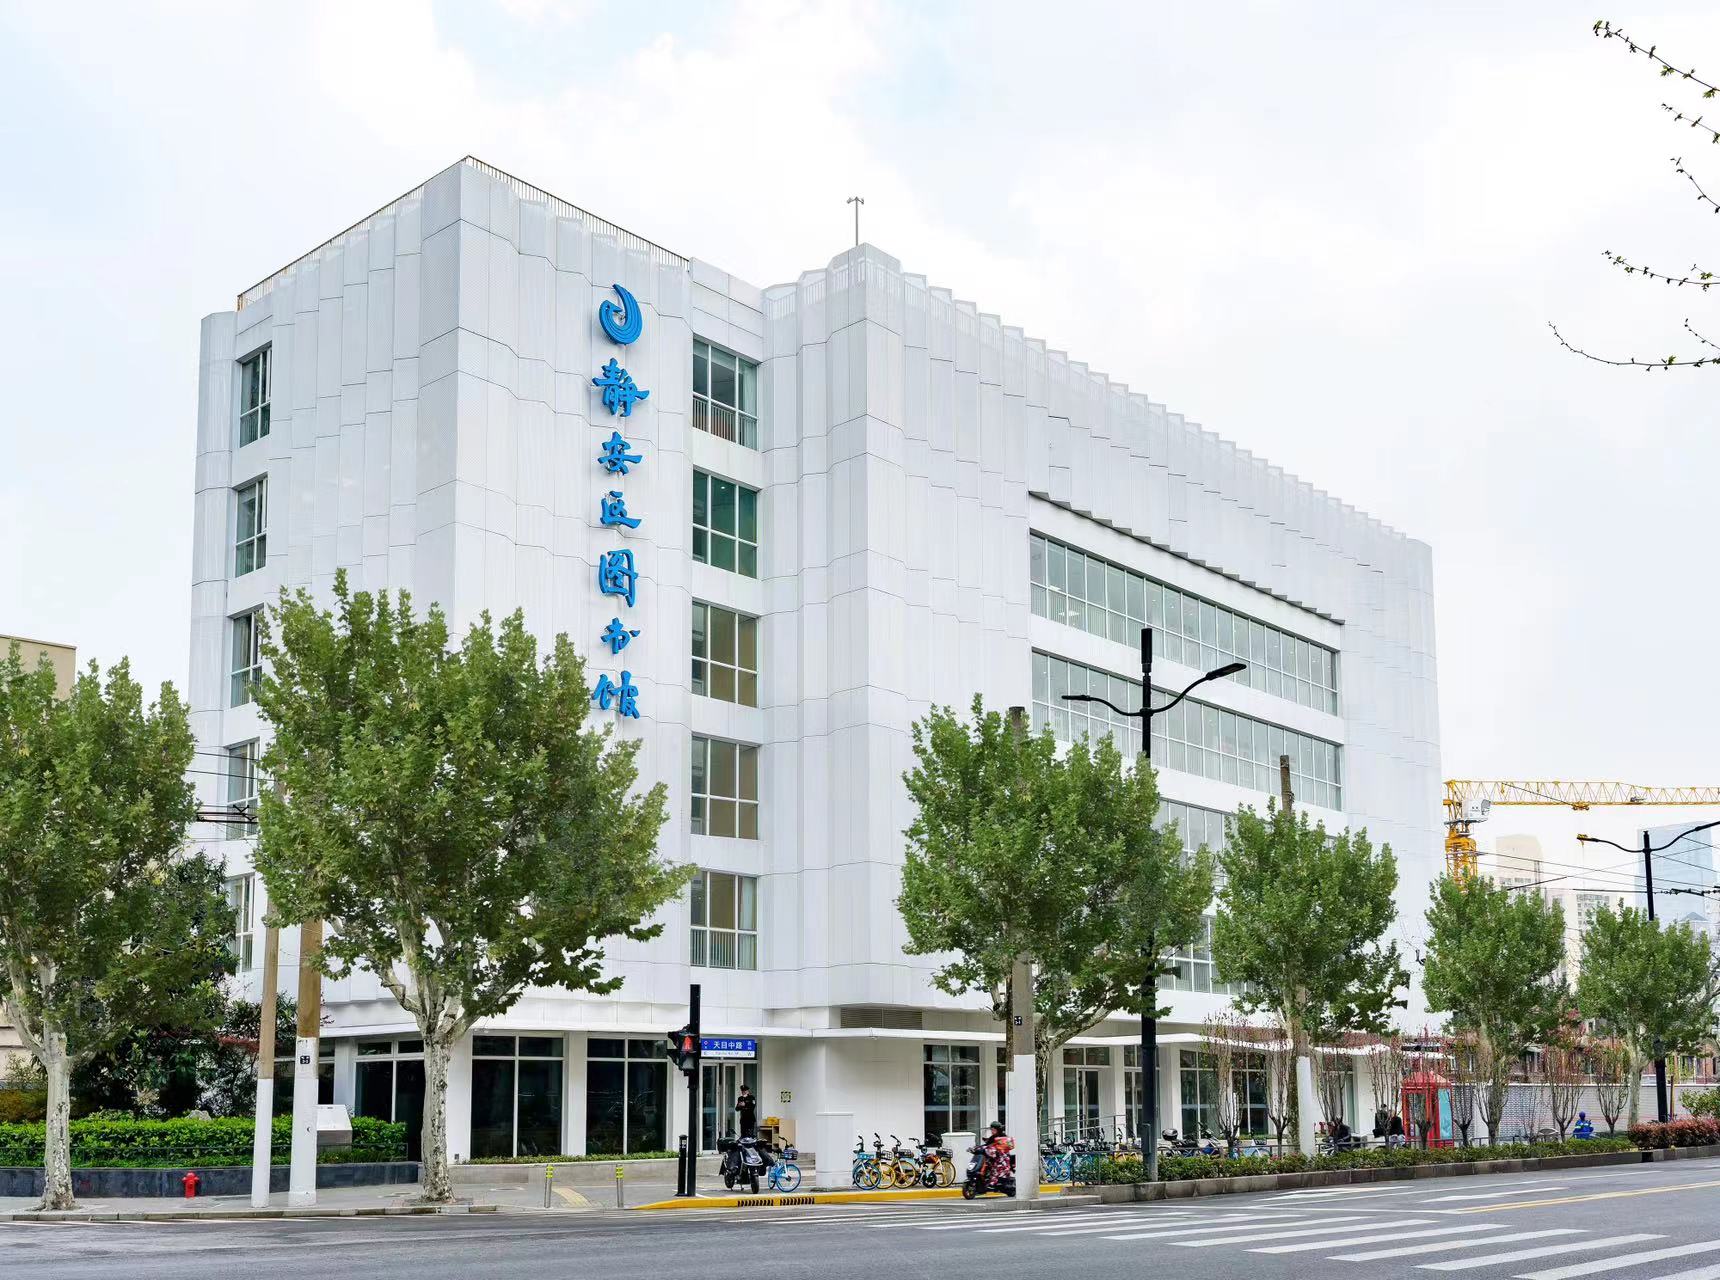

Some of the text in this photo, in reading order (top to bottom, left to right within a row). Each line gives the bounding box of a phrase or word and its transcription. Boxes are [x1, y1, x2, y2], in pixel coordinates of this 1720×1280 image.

[592, 357, 650, 719] 静安区图书馆
[713, 1041, 743, 1050] 天目中路
